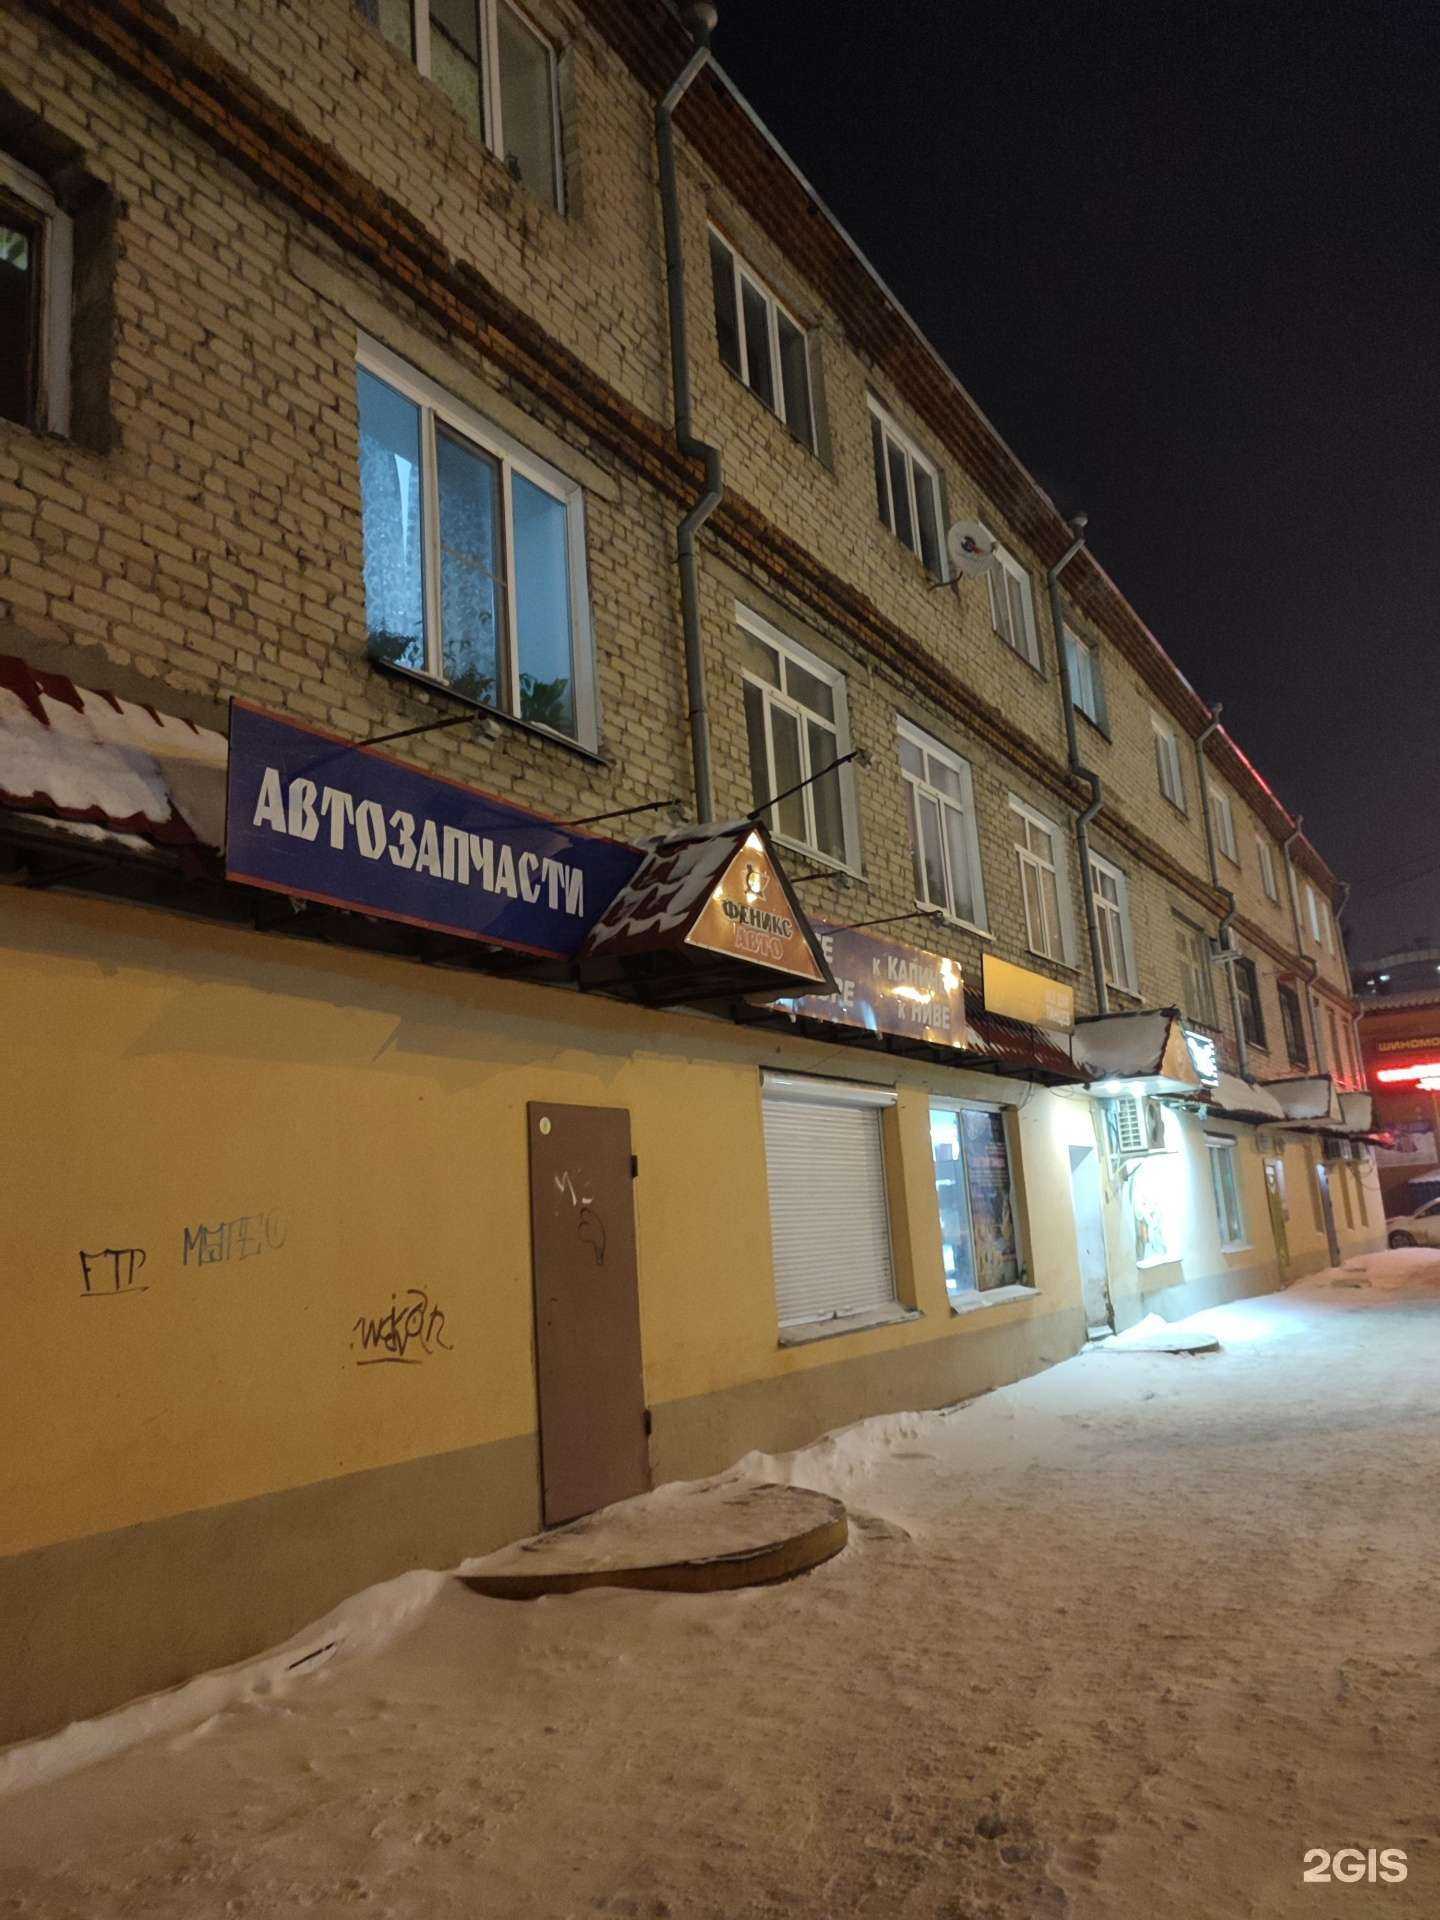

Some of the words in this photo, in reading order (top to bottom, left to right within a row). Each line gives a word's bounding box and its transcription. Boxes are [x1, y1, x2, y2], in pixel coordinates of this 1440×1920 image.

[252, 767, 585, 918] АВТОЗАПЧАСТИ
[721, 900, 792, 939] ФЕНИКС
[735, 926, 784, 961] АВТО
[911, 1003, 951, 1030] НИВЕ
[79, 1248, 147, 1292] FTP
